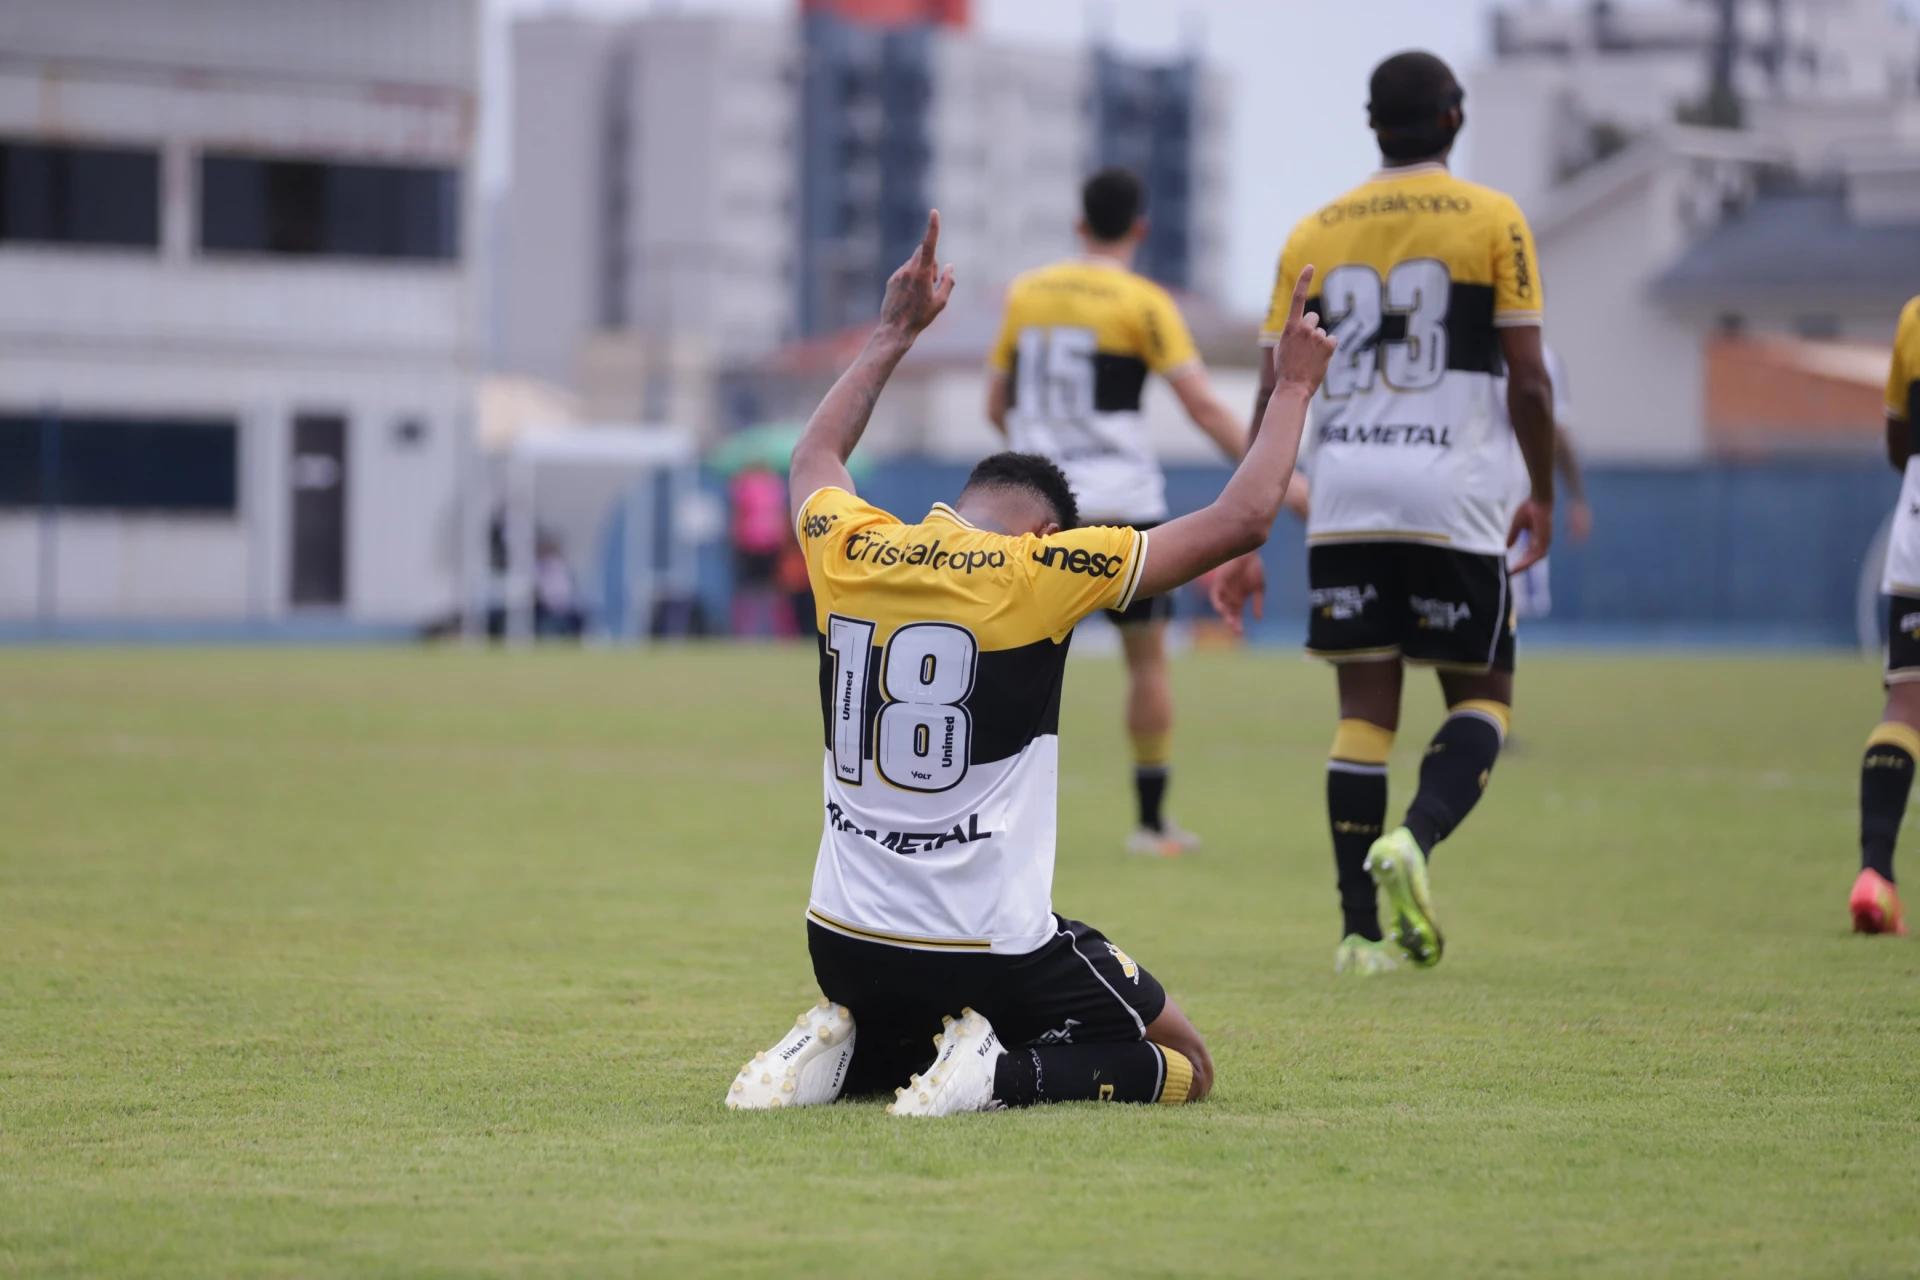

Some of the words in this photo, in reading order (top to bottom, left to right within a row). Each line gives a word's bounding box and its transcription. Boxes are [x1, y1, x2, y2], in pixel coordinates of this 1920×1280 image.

[1321, 257, 1452, 399] 23
[1015, 325, 1098, 421] 15
[827, 614, 979, 793] 18
[842, 670, 854, 721] Unimed
[941, 715, 956, 768] Unimed
[910, 770, 932, 781] VOLT
[780, 1034, 812, 1061] ATHLETA
